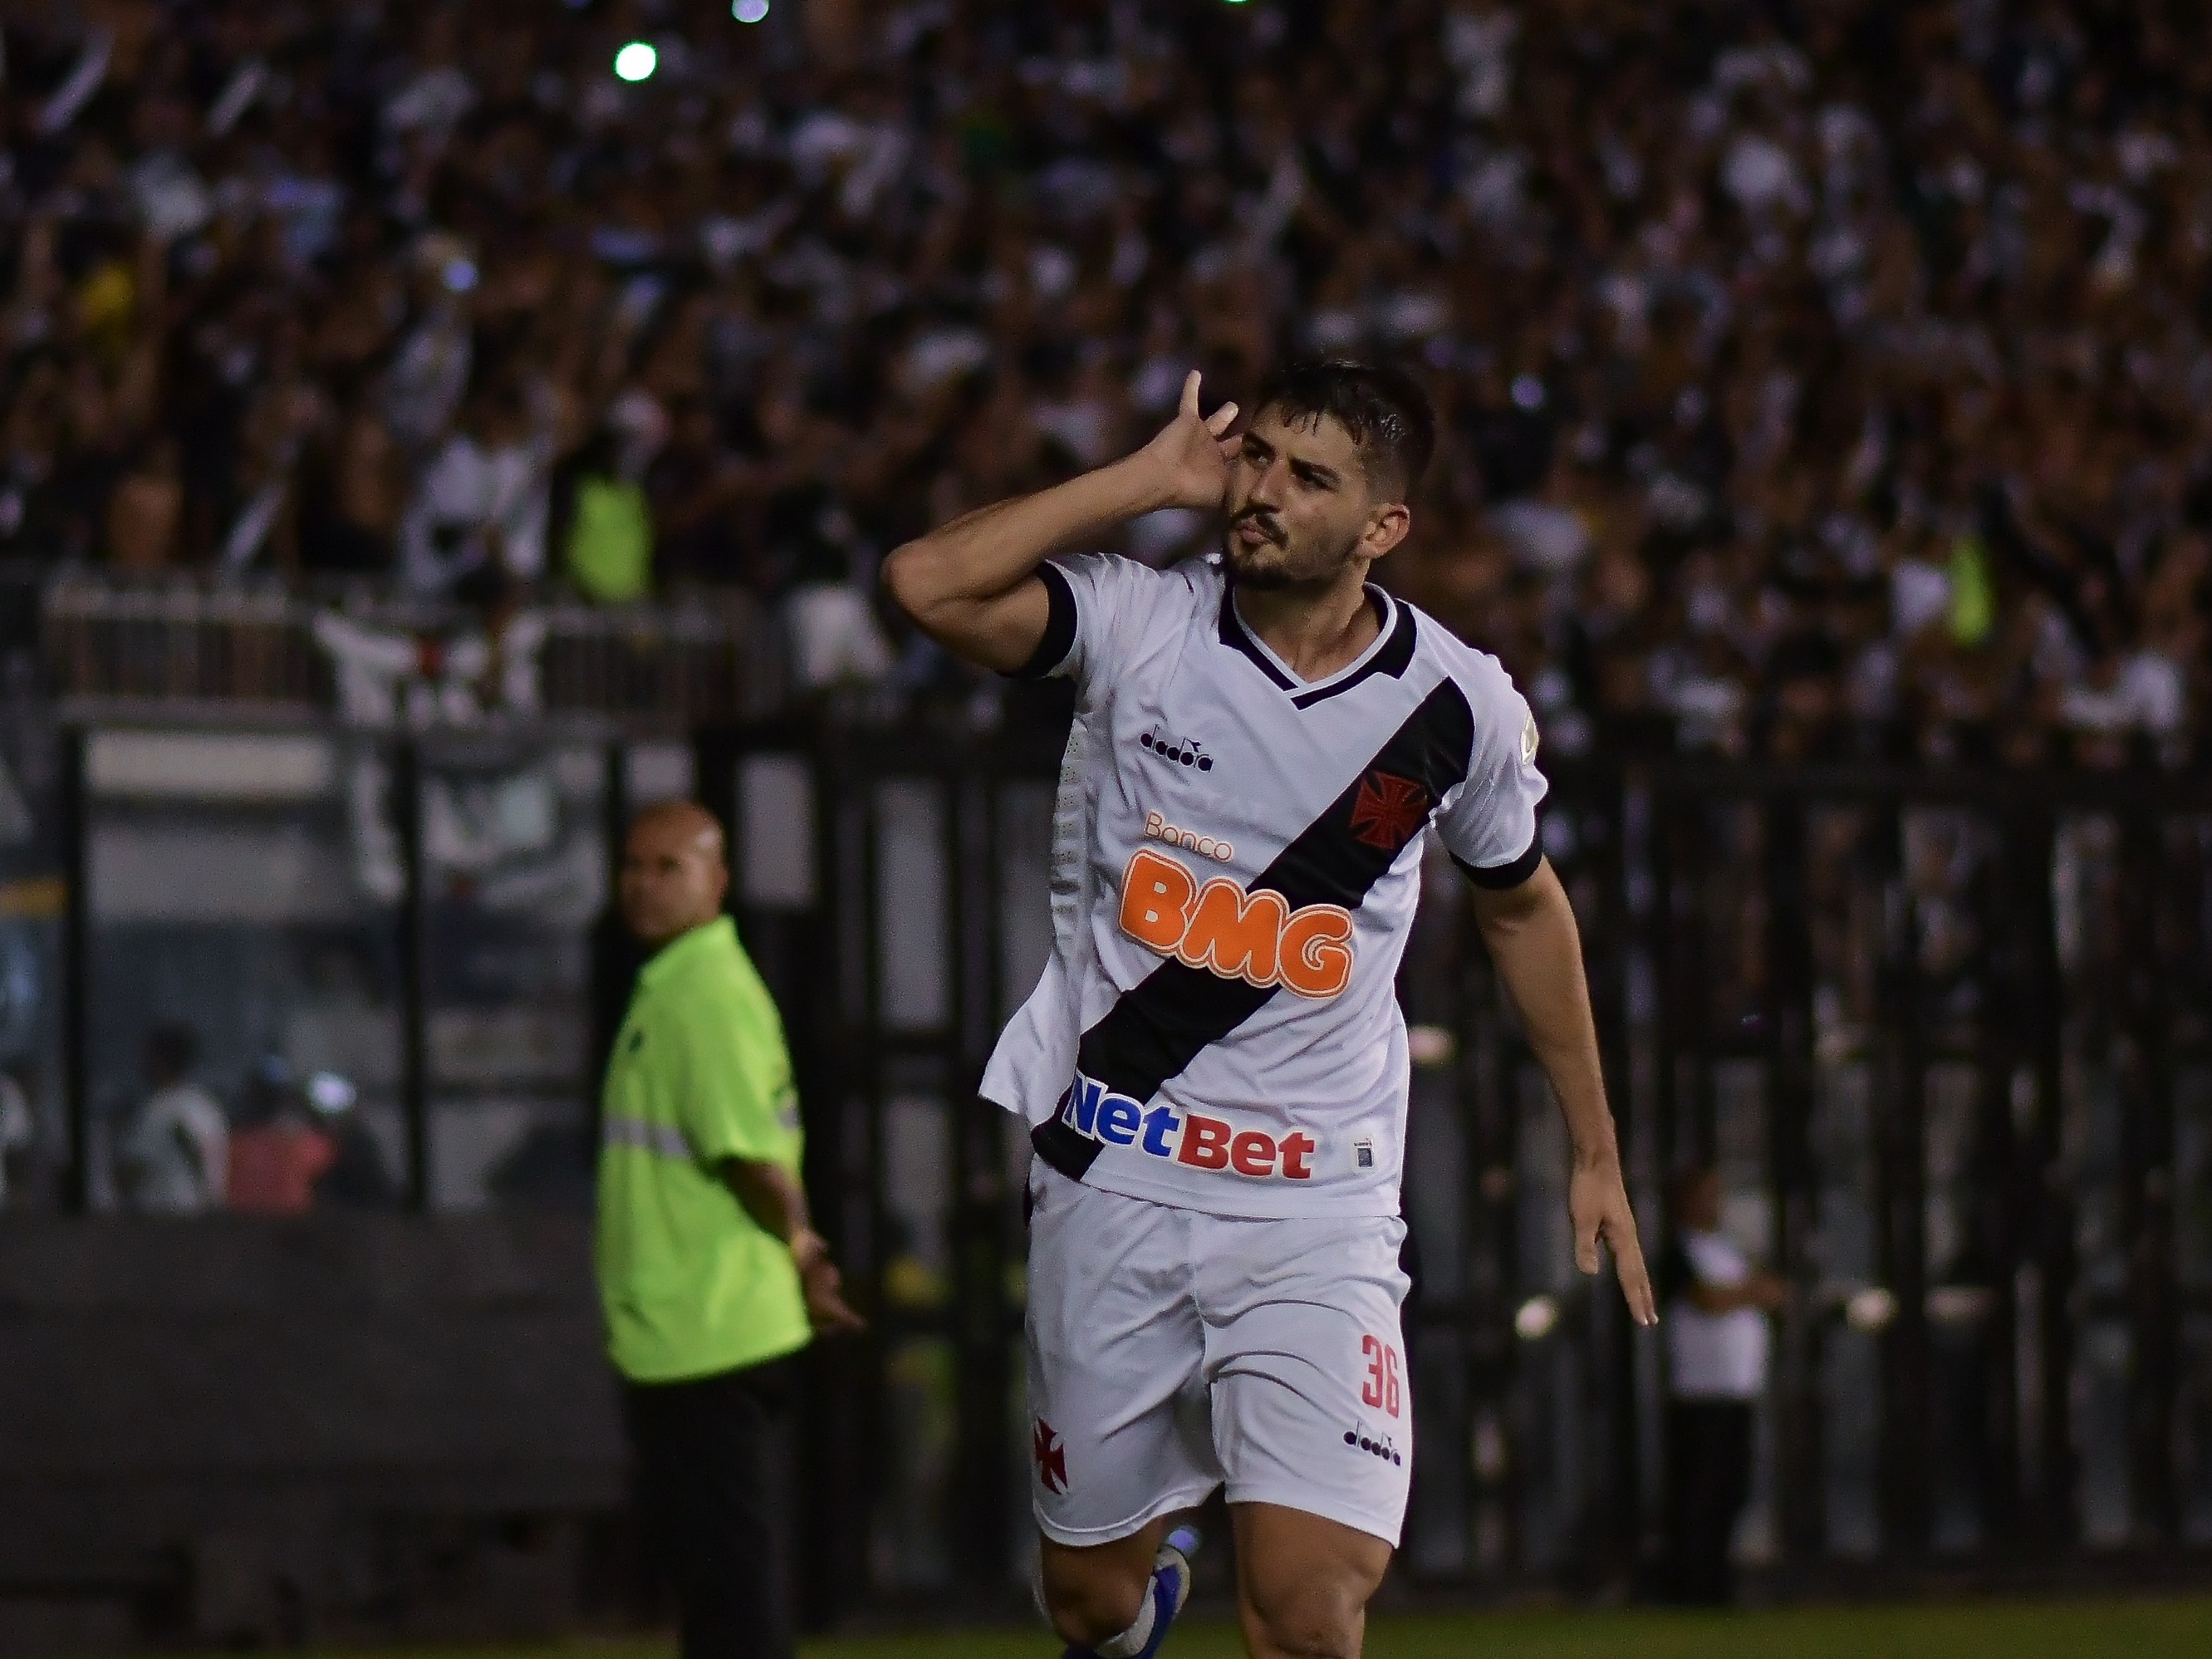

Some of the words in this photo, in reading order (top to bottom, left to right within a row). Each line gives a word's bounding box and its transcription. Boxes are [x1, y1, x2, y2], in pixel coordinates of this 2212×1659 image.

[1140, 724, 1214, 773] diadora
[1145, 811, 1233, 861] Banco
[1118, 848, 1354, 998] BMG
[1062, 1069, 1315, 1180] NetBet
[1361, 1334, 1400, 1419] 36
[1343, 1420, 1401, 1467] diadora
